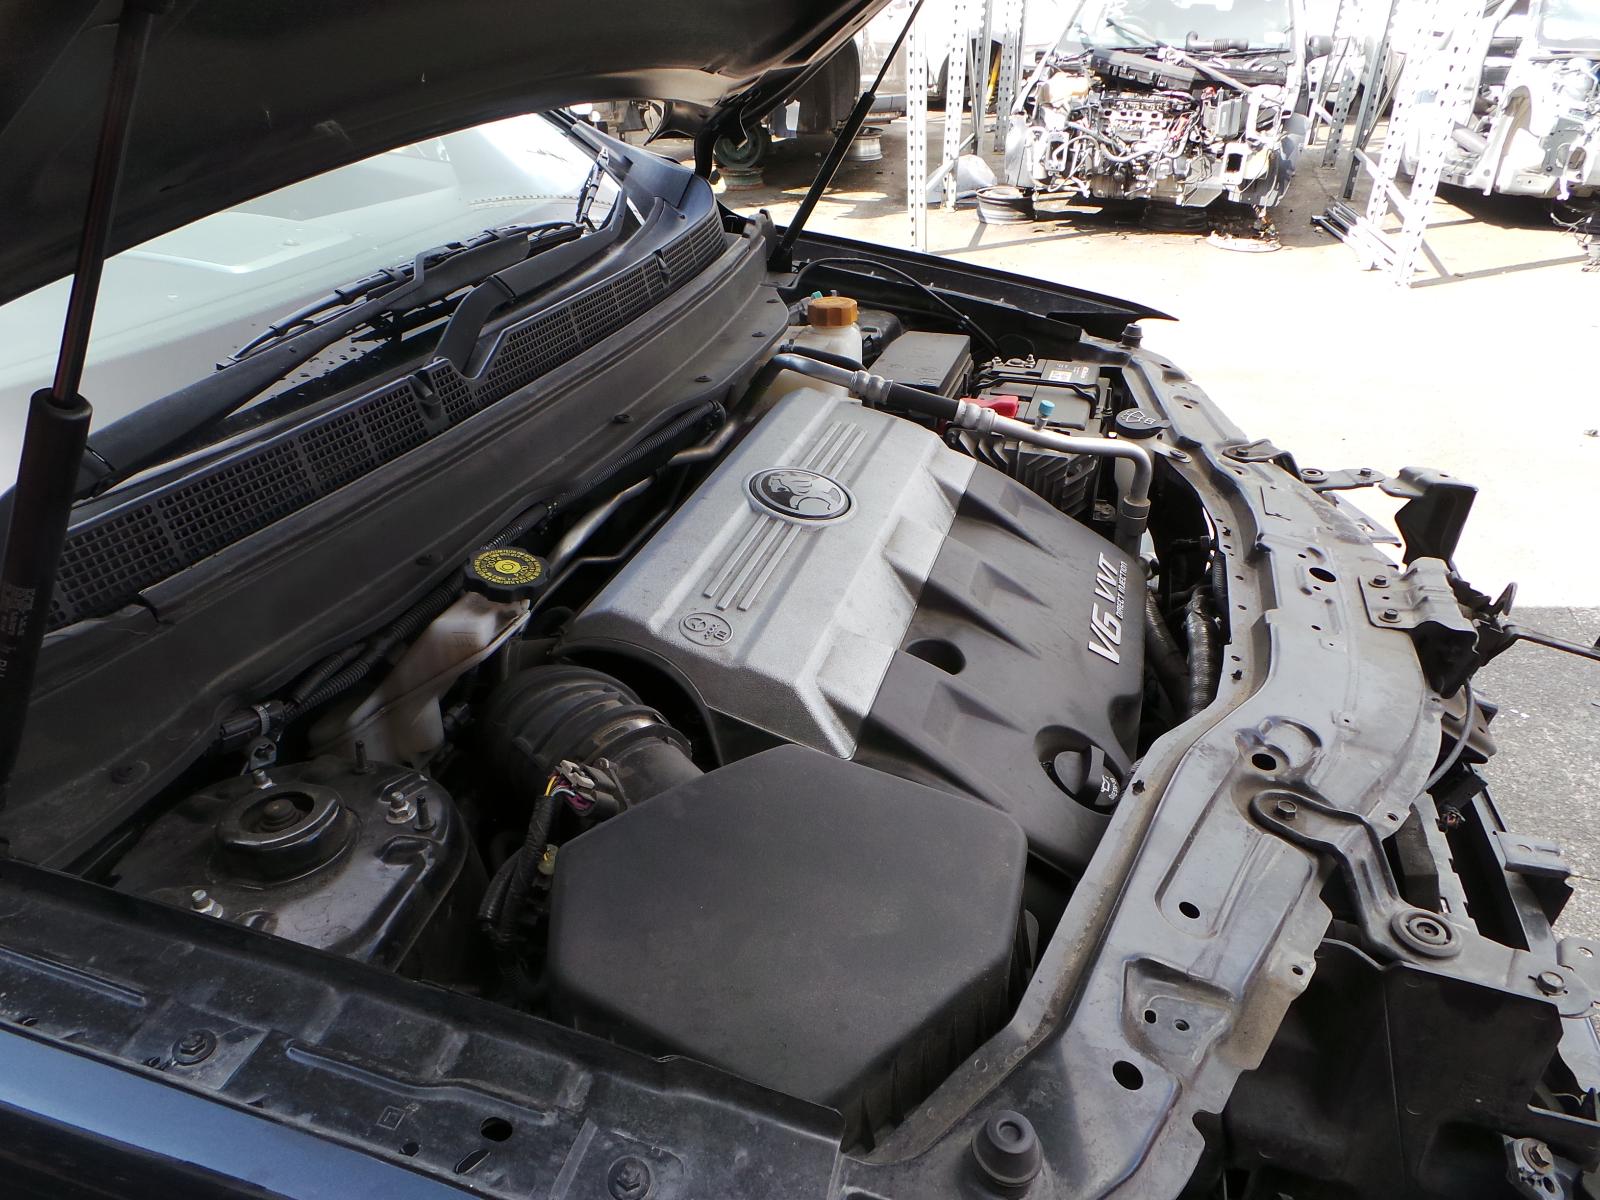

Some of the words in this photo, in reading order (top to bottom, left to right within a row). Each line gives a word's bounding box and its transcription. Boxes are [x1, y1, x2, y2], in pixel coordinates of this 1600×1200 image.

[1095, 552, 1118, 603] VVT
[1118, 561, 1127, 594] INJECTION
[1116, 593, 1125, 619] DIRECT
[1088, 602, 1122, 664] V6
